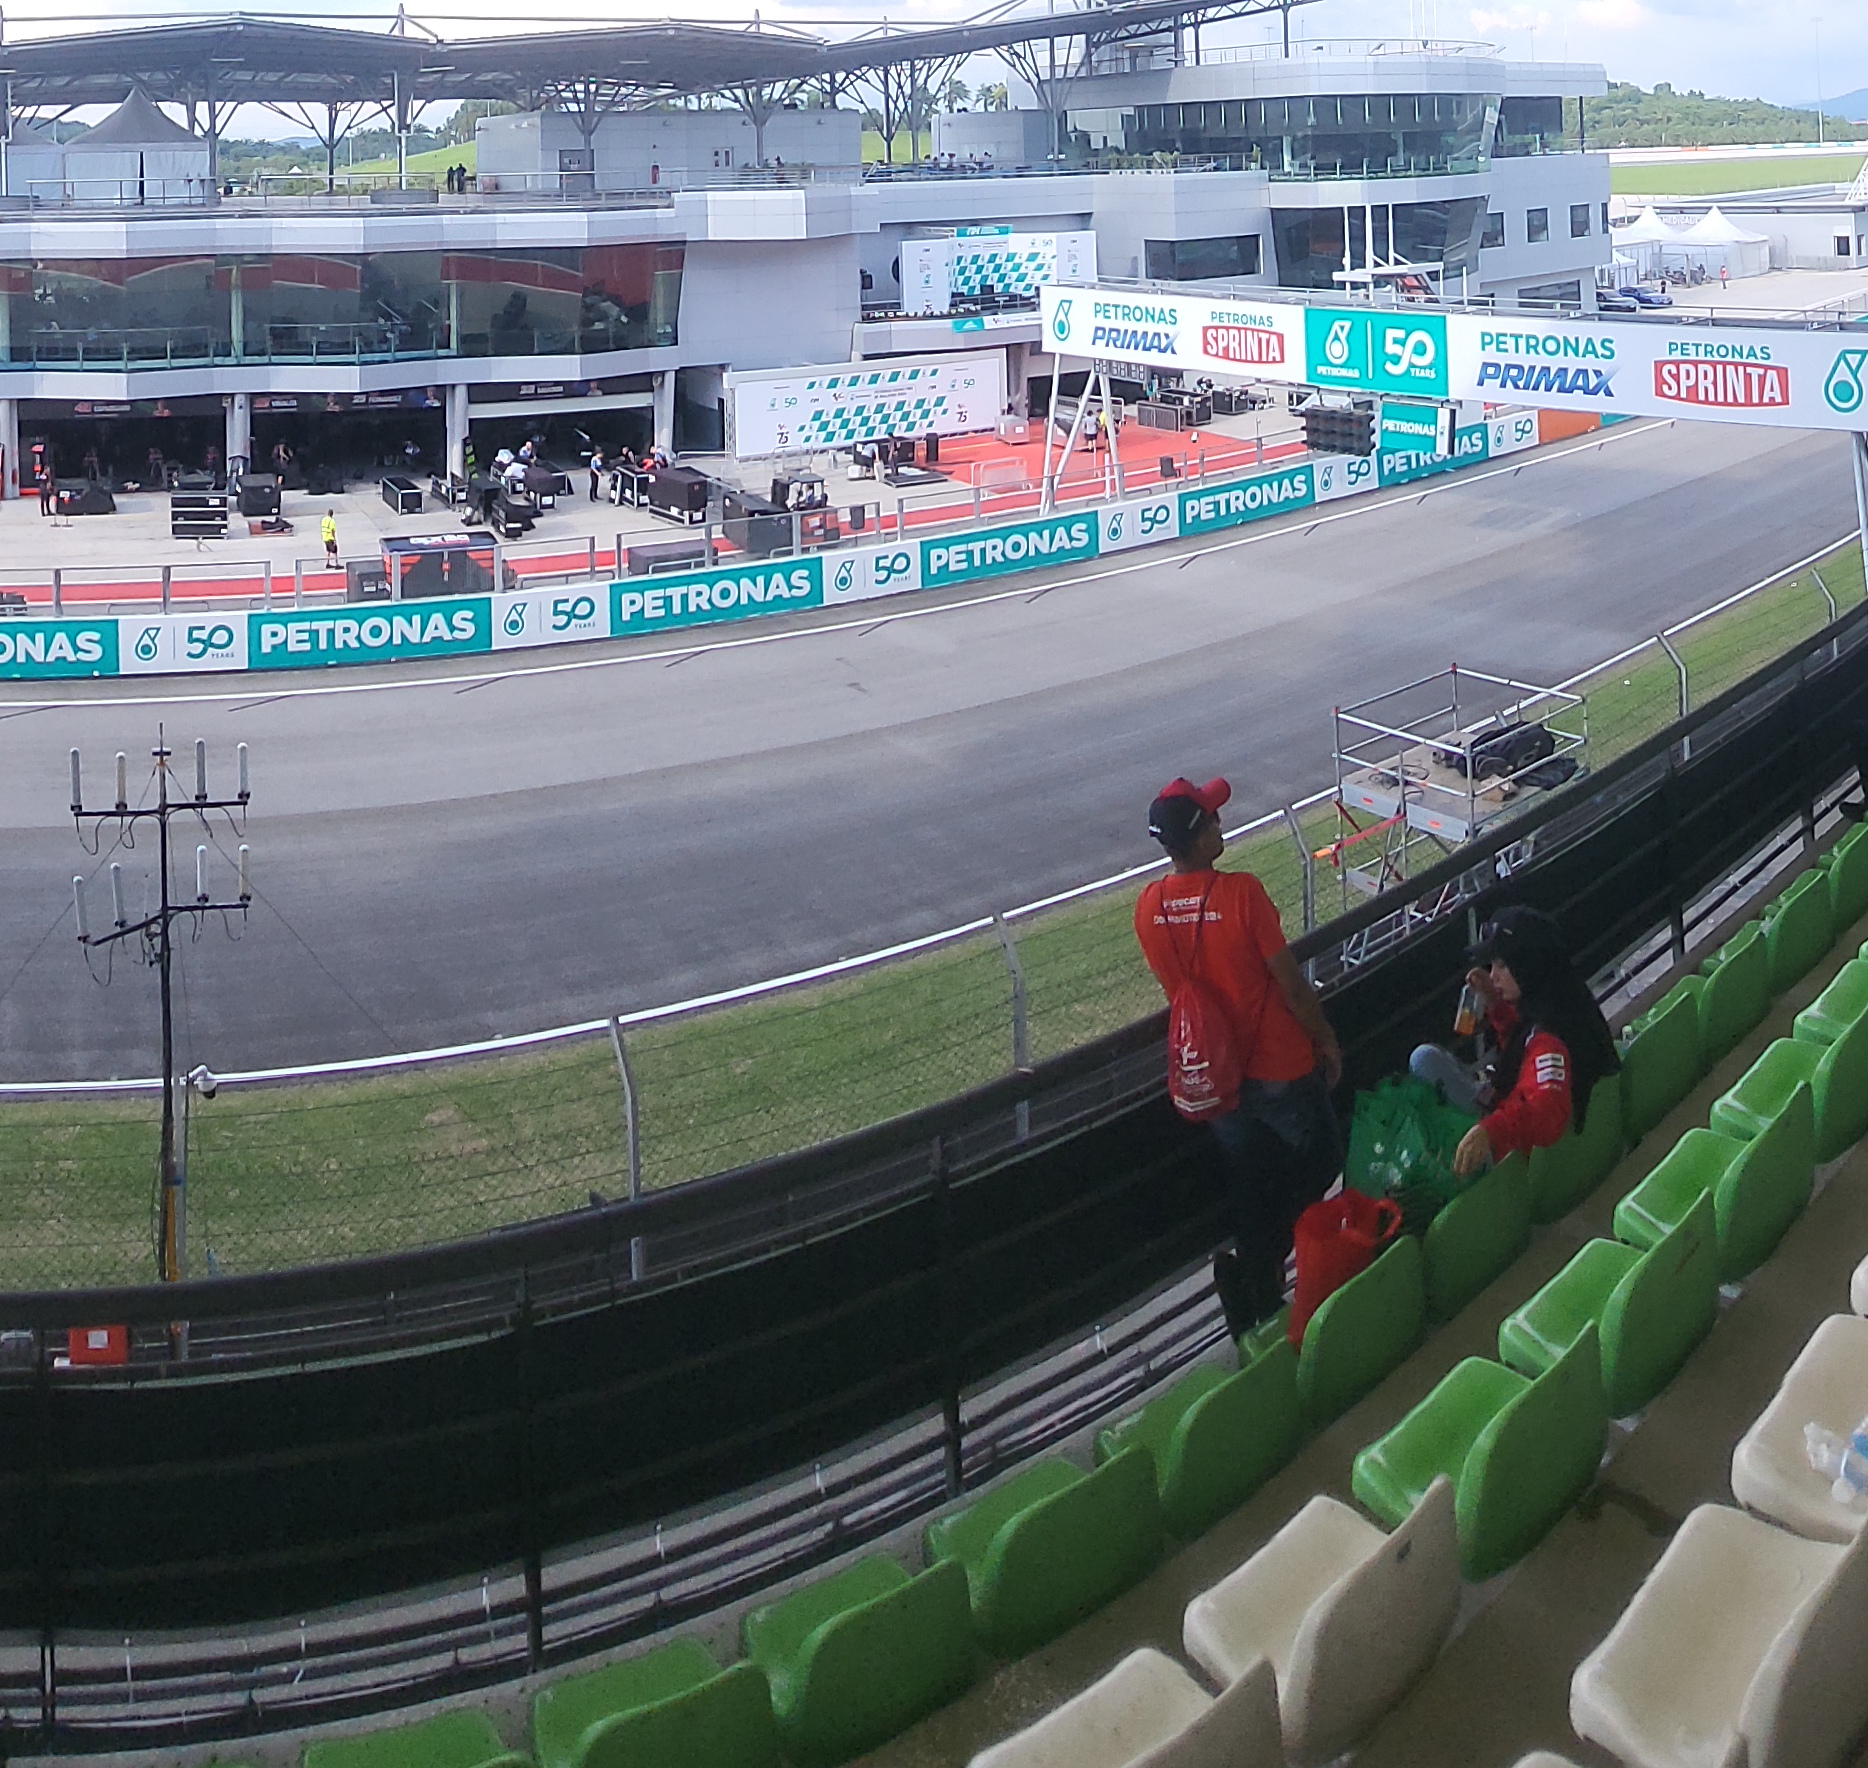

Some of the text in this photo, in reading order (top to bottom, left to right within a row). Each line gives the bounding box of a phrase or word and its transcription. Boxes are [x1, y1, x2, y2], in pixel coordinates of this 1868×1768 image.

[1093, 301, 1178, 326] PETRONAS
[1210, 311, 1274, 328] PETRONAS
[1091, 326, 1181, 356] PRIMAX
[1205, 328, 1282, 363] SPRINTA
[1384, 328, 1437, 376] 50
[1479, 331, 1616, 360] PETRONAS
[1667, 341, 1771, 361] PETRONAS
[1316, 366, 1360, 380] PETRONAS
[1409, 368, 1437, 379] YEARS
[1476, 361, 1622, 398] PRIMAX
[1661, 362, 1783, 405] SPRINTA
[1381, 418, 1437, 437] PETRONAS
[1514, 418, 1534, 443] 50
[1347, 458, 1372, 486] 50
[1185, 474, 1308, 524] PETRONAS
[1140, 504, 1170, 535] 50
[929, 523, 1090, 575] PETRONAS
[873, 551, 911, 585] 50
[620, 569, 811, 621] PETRONAS
[551, 595, 596, 631] 50
[574, 620, 596, 629] YEARS
[186, 624, 235, 660] 50
[260, 610, 476, 653] PETRONAS
[211, 651, 235, 659] YEARS
